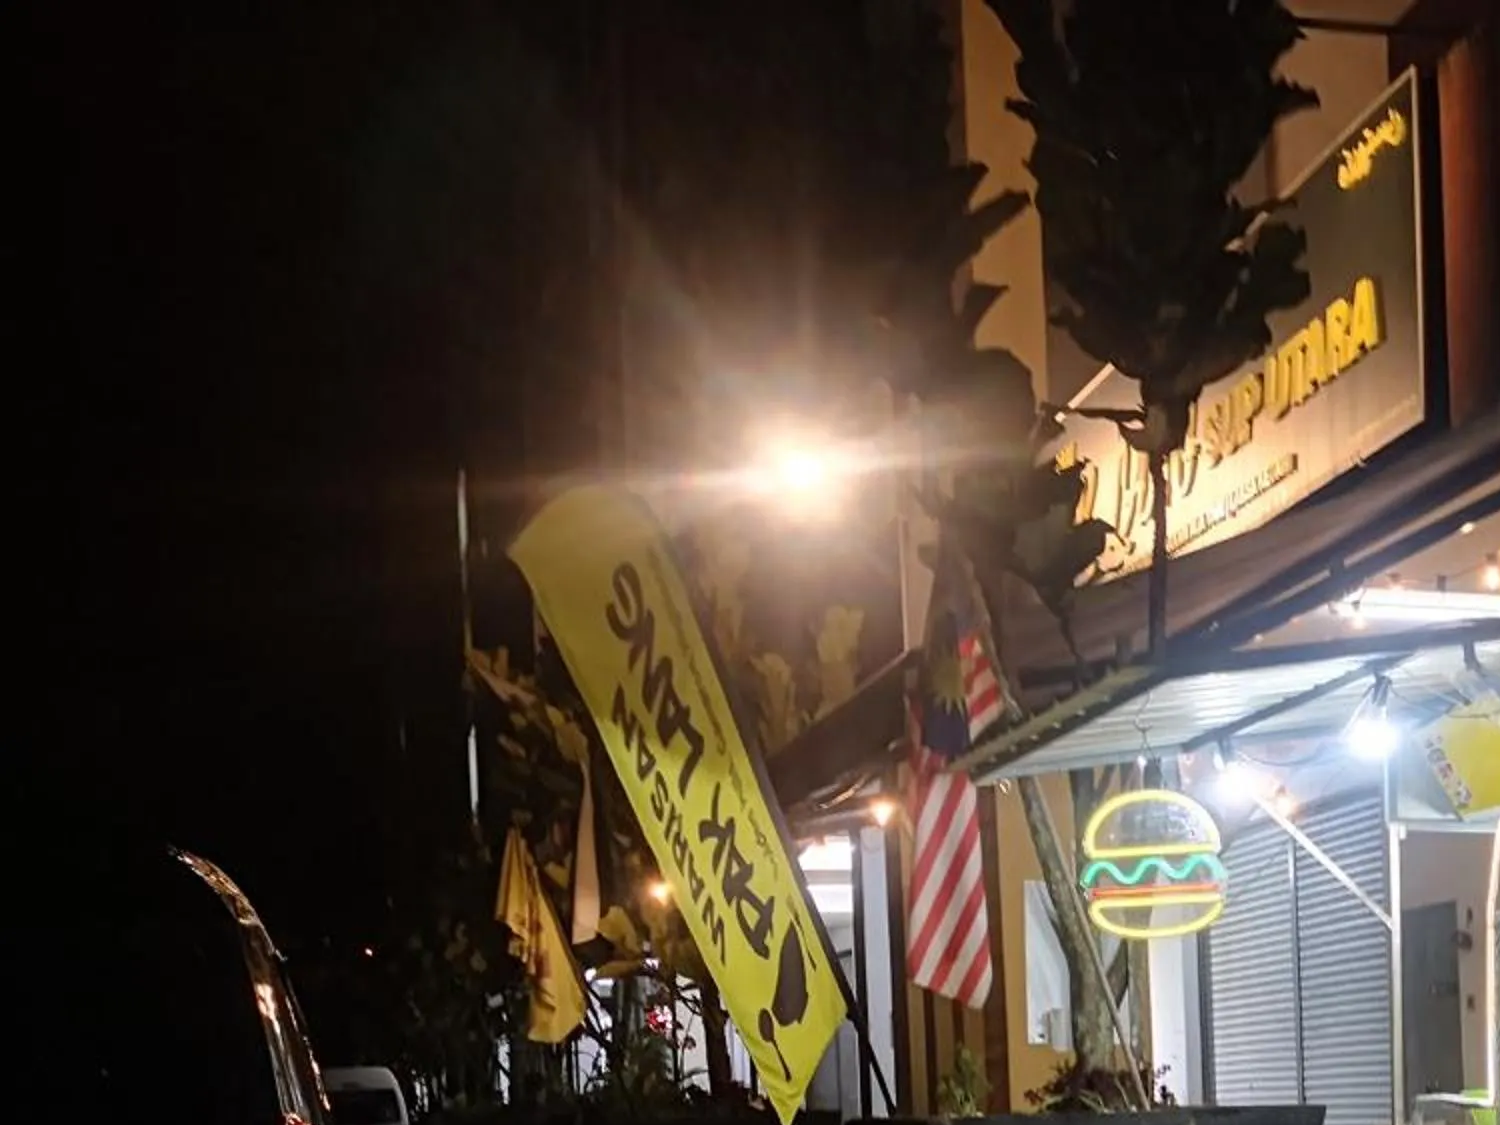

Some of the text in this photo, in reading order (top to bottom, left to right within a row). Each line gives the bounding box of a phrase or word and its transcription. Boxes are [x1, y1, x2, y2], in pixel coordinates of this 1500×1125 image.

[1263, 277, 1380, 420] UTARA
[606, 560, 704, 801] LANG
[611, 680, 727, 967] WARISAN
[698, 781, 775, 961] PAK
